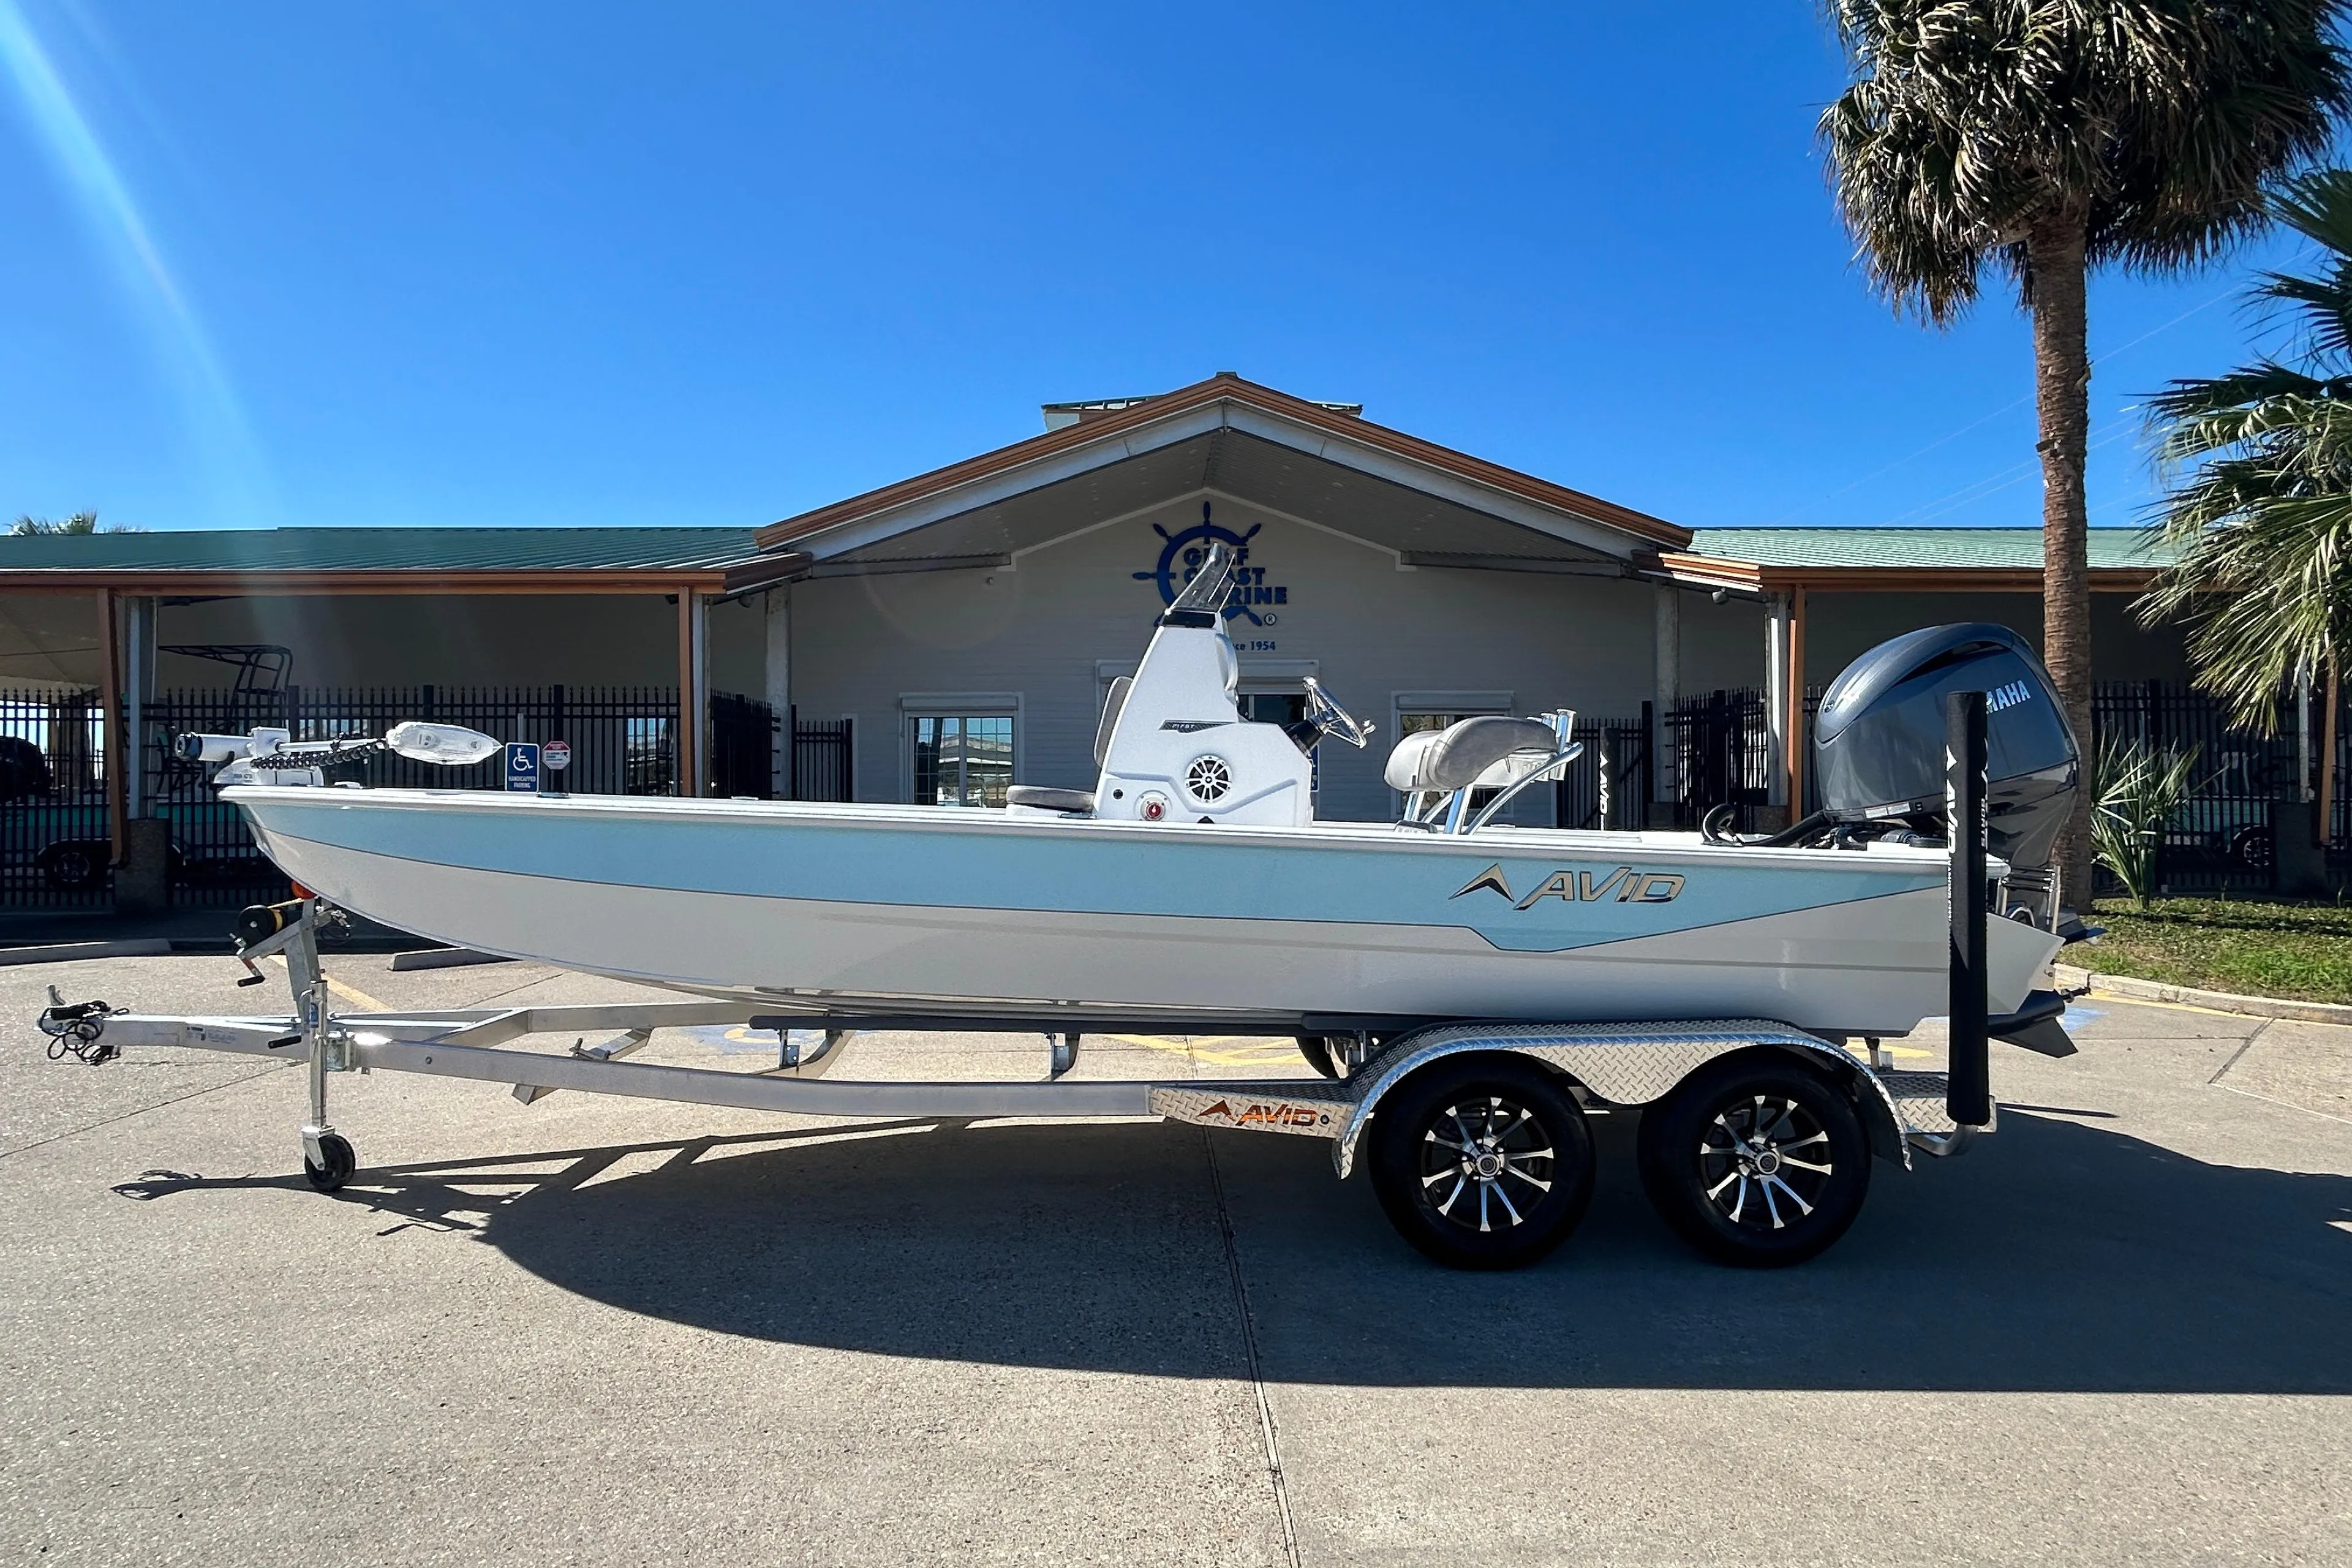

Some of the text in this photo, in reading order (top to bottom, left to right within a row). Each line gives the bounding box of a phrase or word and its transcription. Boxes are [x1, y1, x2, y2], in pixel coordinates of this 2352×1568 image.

[1250, 641, 1276, 650] 1954
[1986, 680, 2031, 715] MAHA
[1512, 867, 1686, 911] AVID
[1235, 1104, 1317, 1126] AVID
